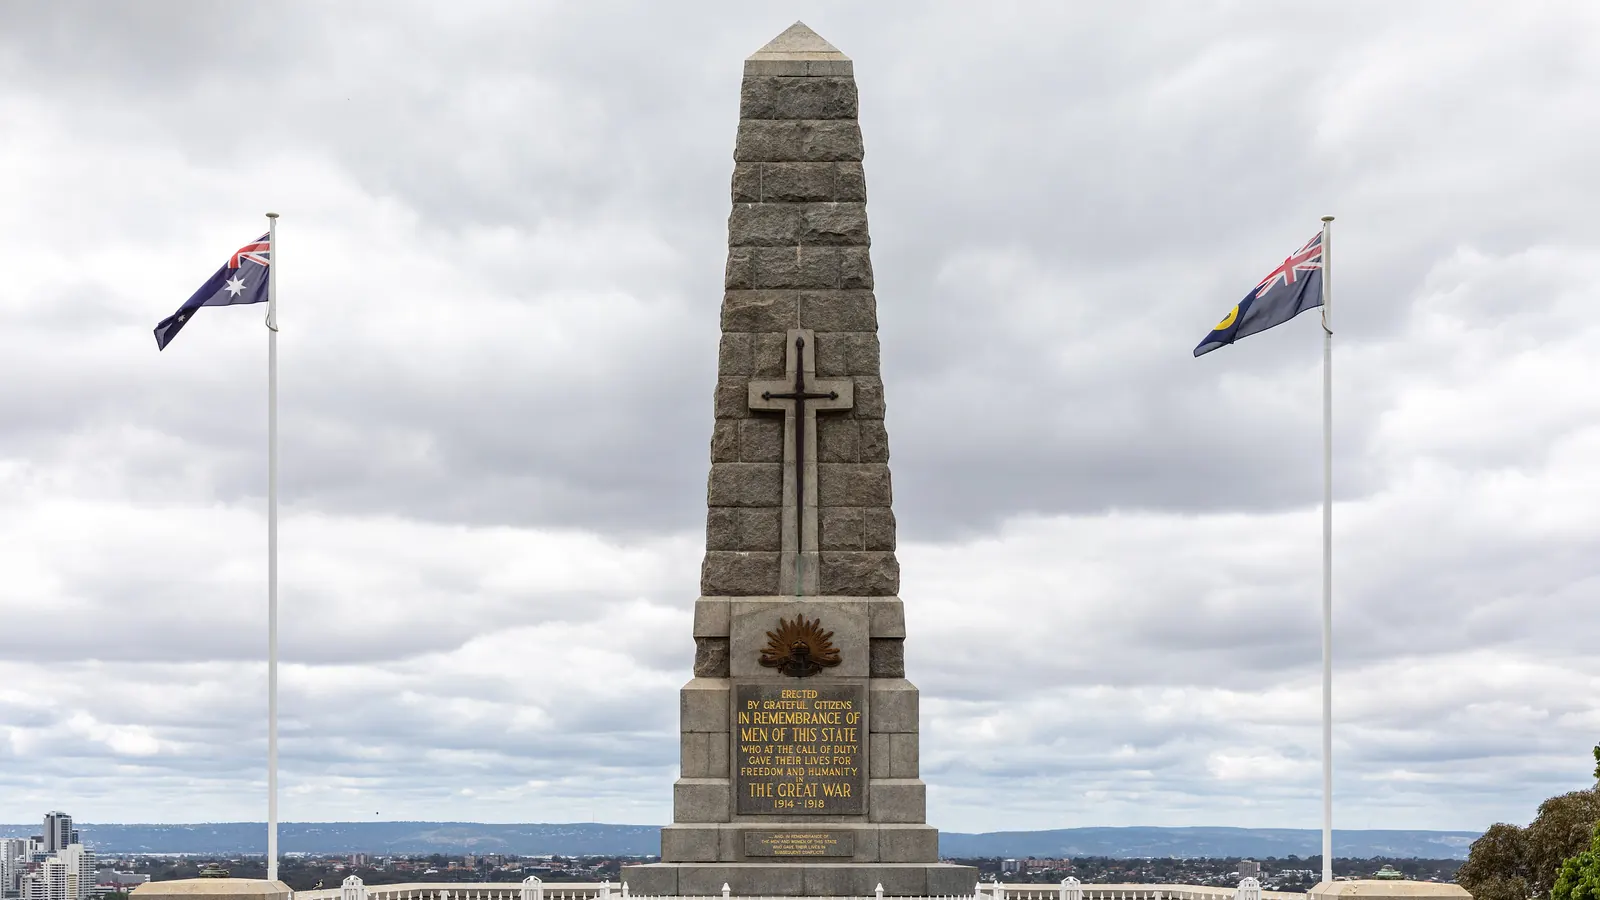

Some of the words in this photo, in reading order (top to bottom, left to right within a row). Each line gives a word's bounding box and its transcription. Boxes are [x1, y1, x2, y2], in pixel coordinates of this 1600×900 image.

[782, 690, 817, 698] ERECTED
[748, 701, 760, 710] BY
[764, 701, 808, 710] GRATEFUL
[814, 701, 852, 710] CITIZENS
[738, 712, 750, 724] IN
[754, 712, 840, 724] REMEMBRANCE
[846, 712, 860, 724] OF
[742, 728, 768, 742] MEN
[772, 728, 787, 742] OF
[793, 728, 817, 742] THIS
[822, 728, 857, 742] STATE
[742, 745, 761, 754] WHO
[764, 745, 774, 754] AT
[777, 745, 793, 754] THE
[796, 745, 817, 754] CALL
[820, 745, 831, 754] OF
[834, 746, 858, 754] DUTY
[749, 756, 771, 764] GAVE
[775, 756, 801, 764] THEIR
[805, 756, 830, 764] LIVES
[834, 756, 851, 764] FOR
[741, 768, 783, 776] FREEDOM
[787, 768, 804, 776] AND
[808, 768, 858, 776] HUMANITY
[749, 783, 773, 797] THE
[778, 783, 818, 797] GREAT
[822, 783, 851, 797] WAR
[774, 800, 794, 808] 1914
[804, 800, 824, 808] 1918
